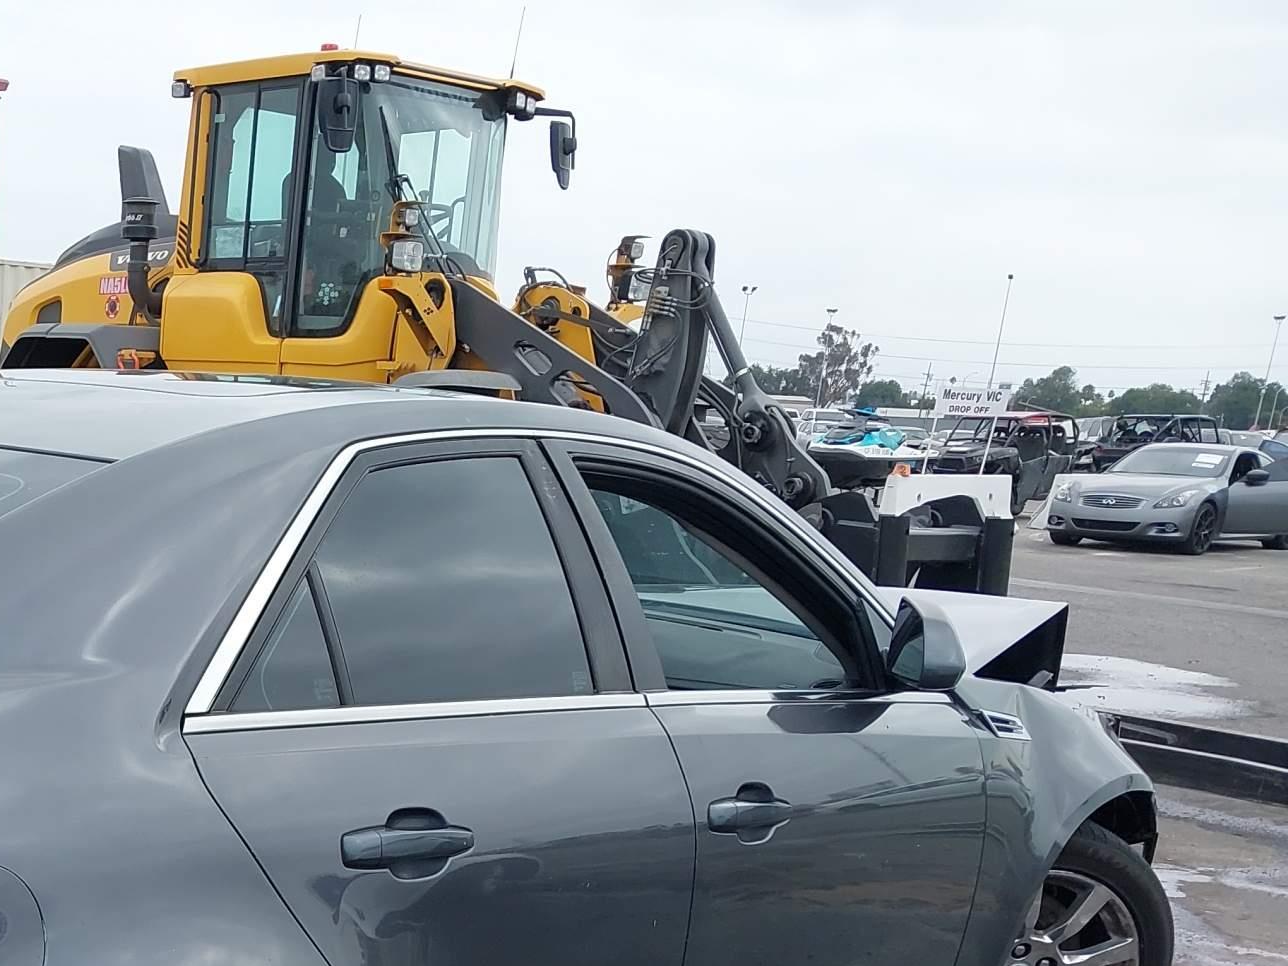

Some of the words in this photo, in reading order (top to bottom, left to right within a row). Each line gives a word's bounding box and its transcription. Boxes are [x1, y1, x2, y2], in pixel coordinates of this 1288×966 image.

[942, 388, 982, 403] Mercury
[986, 391, 1002, 402] VIC
[948, 405, 971, 414] DROP
[973, 406, 991, 414] OFF
